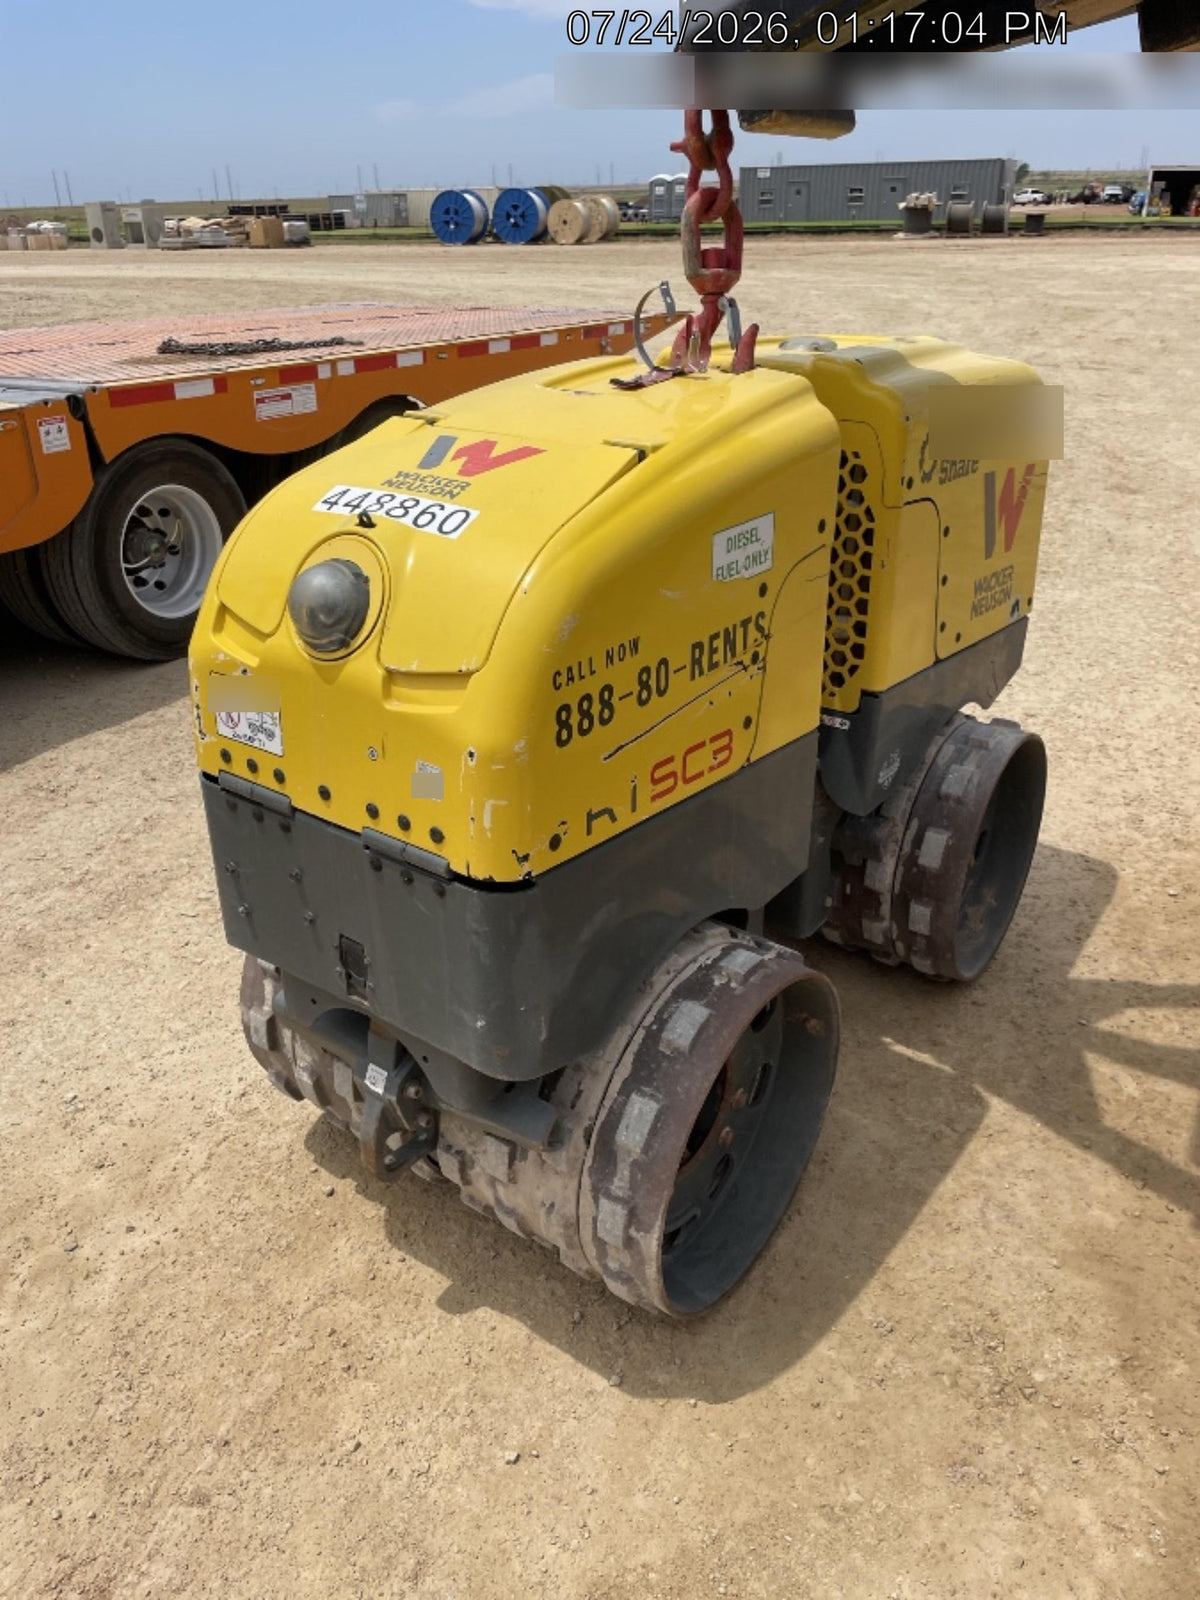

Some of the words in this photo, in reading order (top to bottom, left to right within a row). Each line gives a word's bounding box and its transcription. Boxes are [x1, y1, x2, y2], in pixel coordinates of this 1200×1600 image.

[380, 478, 463, 500] NEUSON
[394, 470, 472, 493] WACKER
[320, 487, 471, 535] 448860
[726, 526, 761, 554] DIESEL
[716, 560, 740, 581] FUEL
[744, 547, 770, 571] ONLY
[974, 564, 1014, 600] WACKER
[970, 583, 1012, 621] NEUSON
[552, 656, 597, 692] CALL
[605, 636, 641, 669] NOW
[555, 610, 766, 749] 888-80-RENTS
